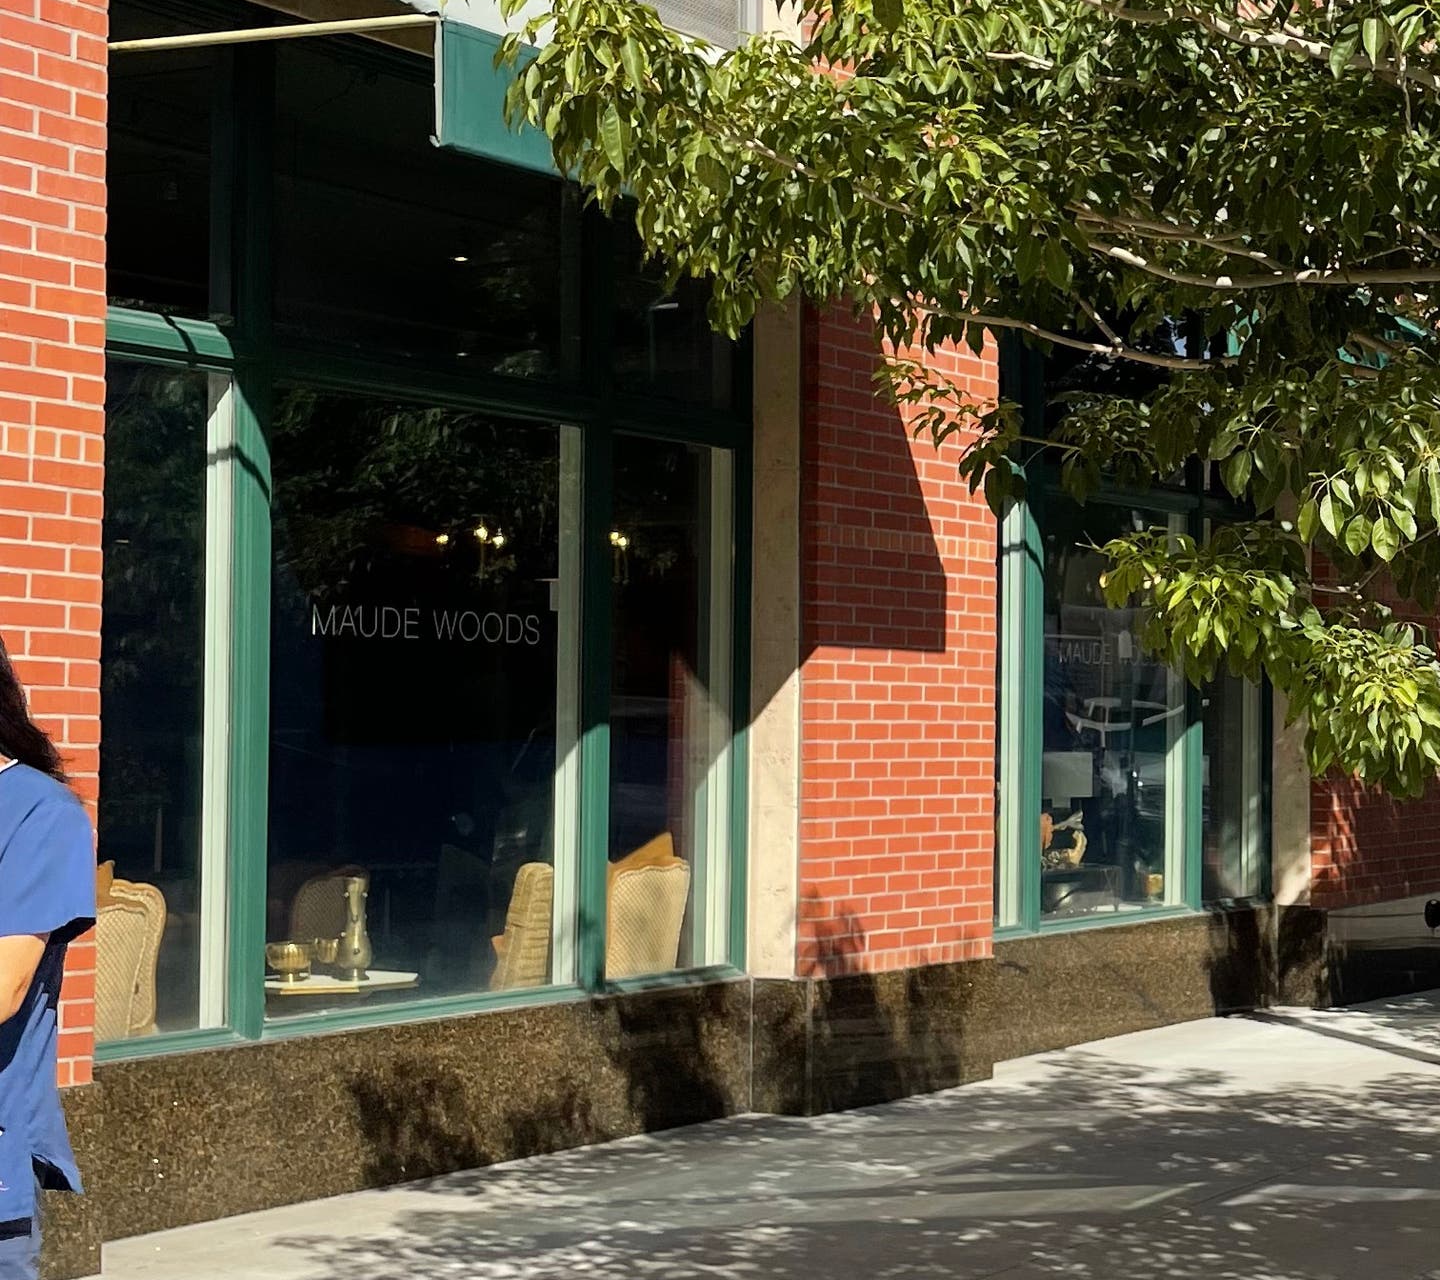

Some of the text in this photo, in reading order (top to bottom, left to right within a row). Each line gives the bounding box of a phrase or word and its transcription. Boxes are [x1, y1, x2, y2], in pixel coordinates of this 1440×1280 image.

[311, 603, 541, 646] MAUDE WOODS
[1058, 640, 1113, 665] MAUDE
